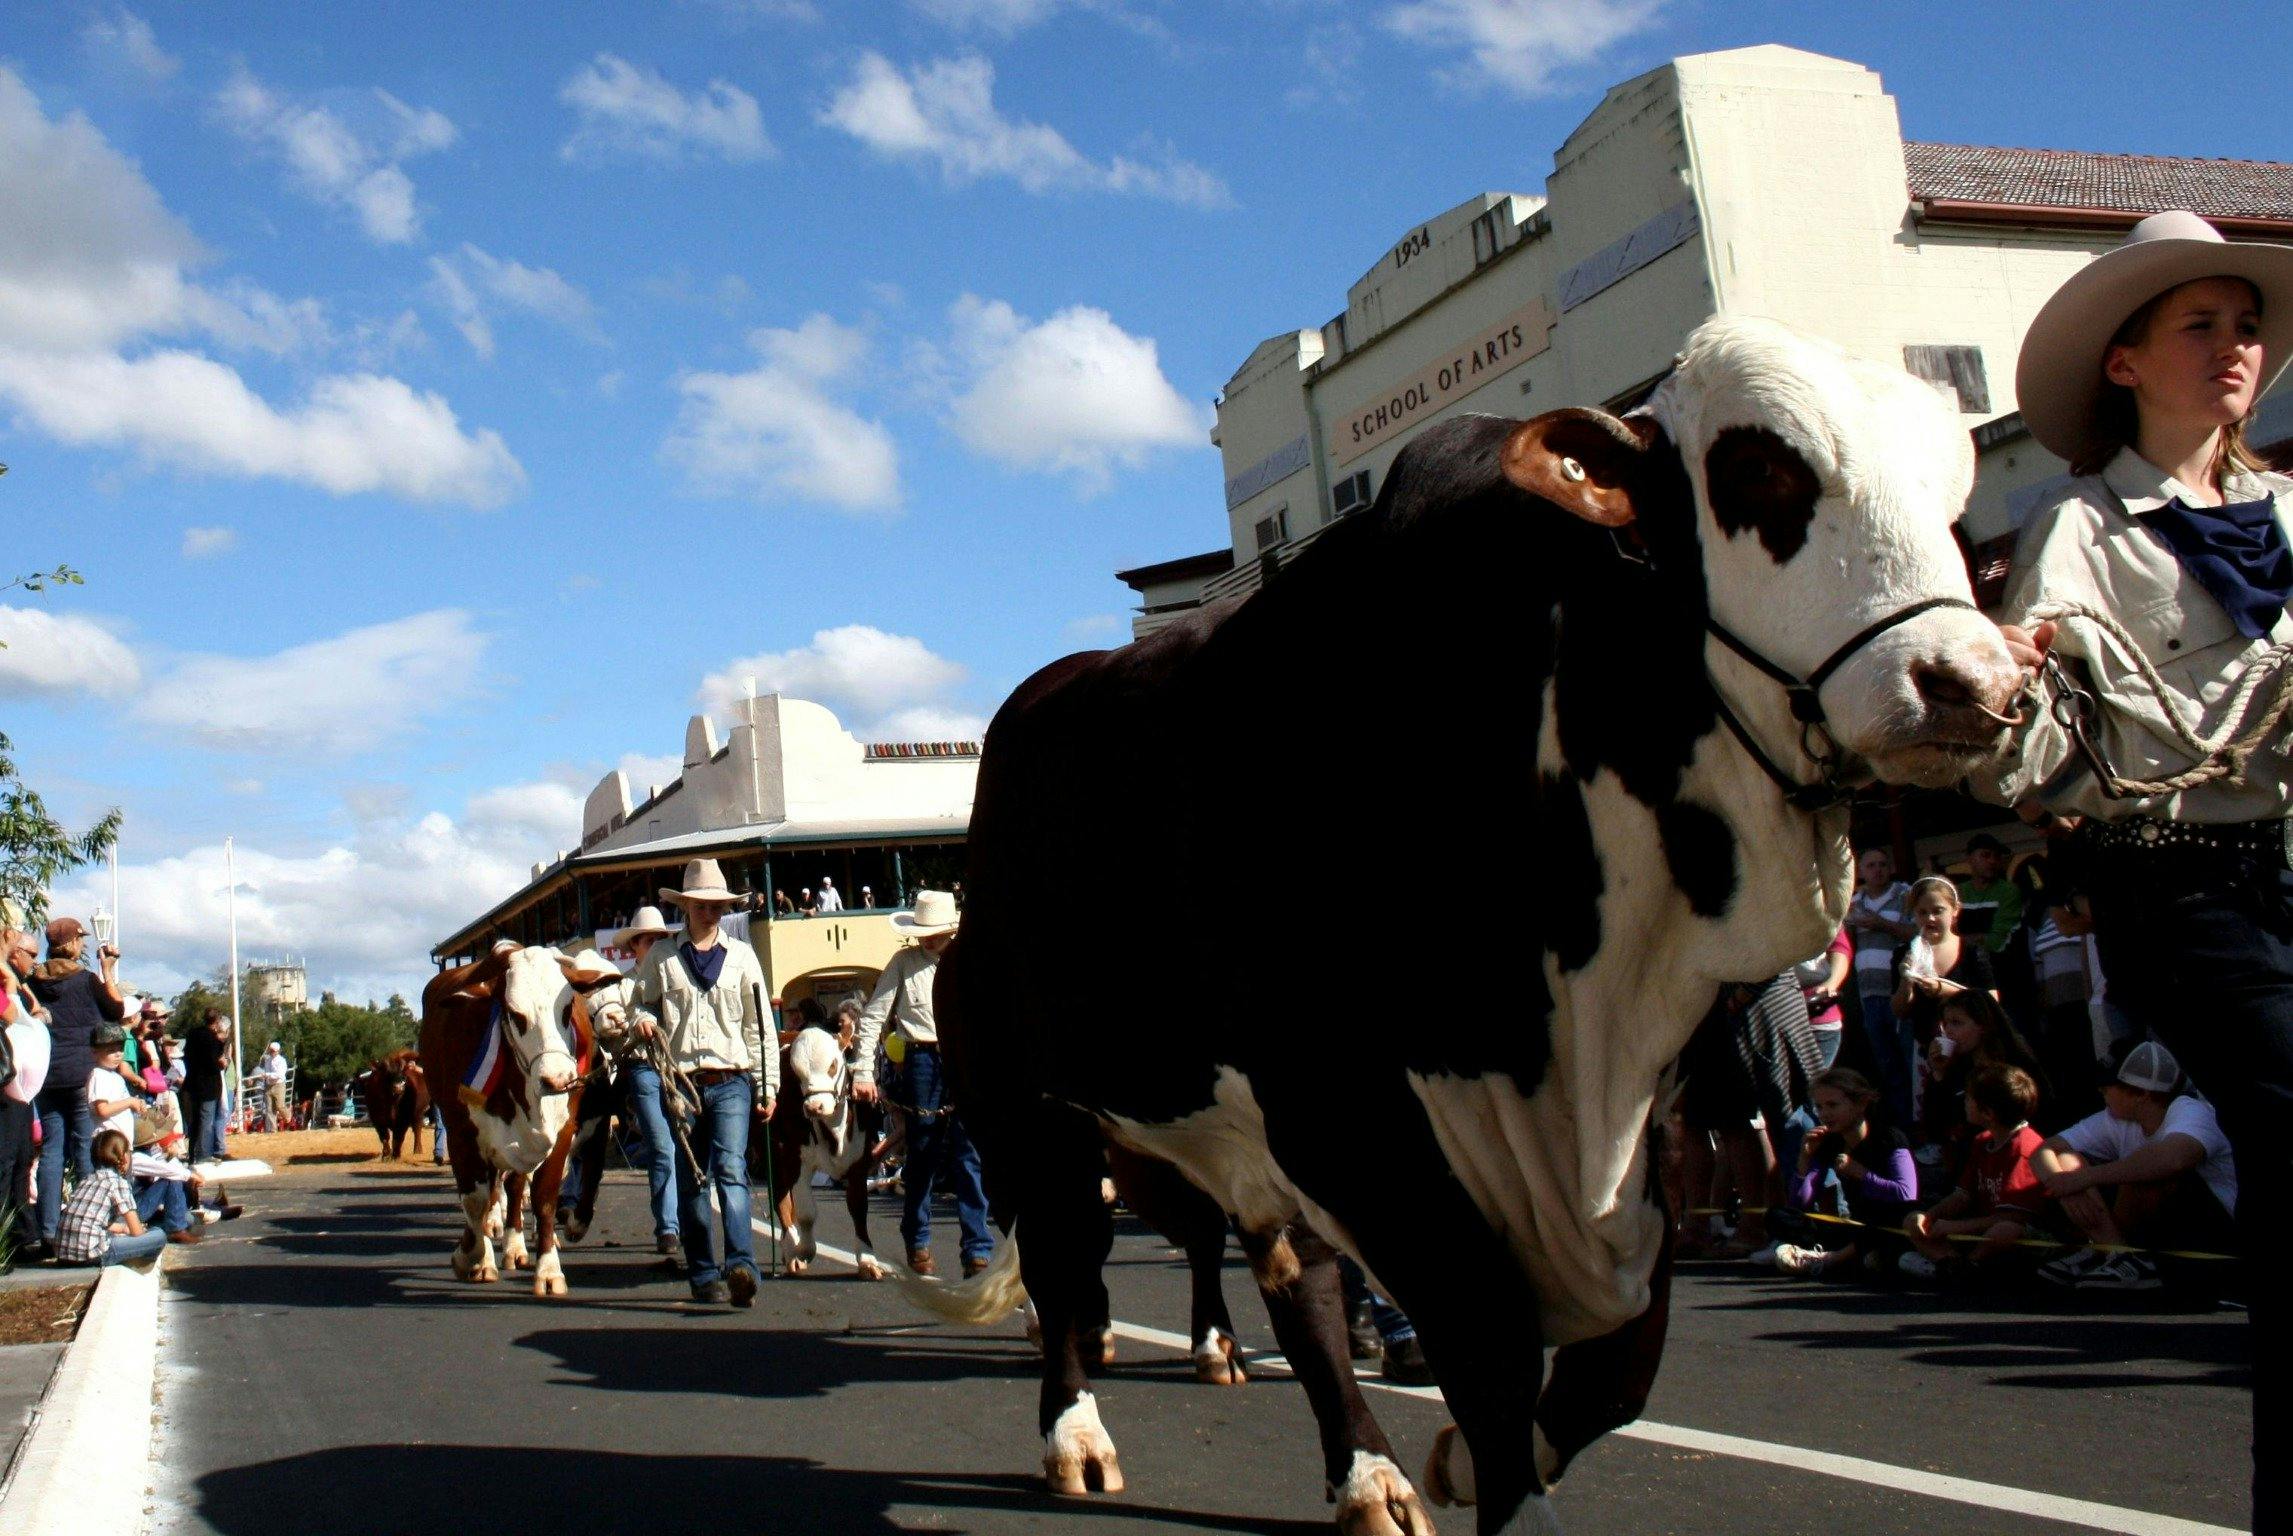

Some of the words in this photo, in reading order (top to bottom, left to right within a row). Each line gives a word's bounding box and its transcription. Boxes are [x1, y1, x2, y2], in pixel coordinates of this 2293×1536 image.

[1395, 227, 1430, 268] 1934
[1352, 383, 1429, 442] SCHOOL
[1438, 359, 1463, 391] OF
[1471, 325, 1523, 374] ARTS
